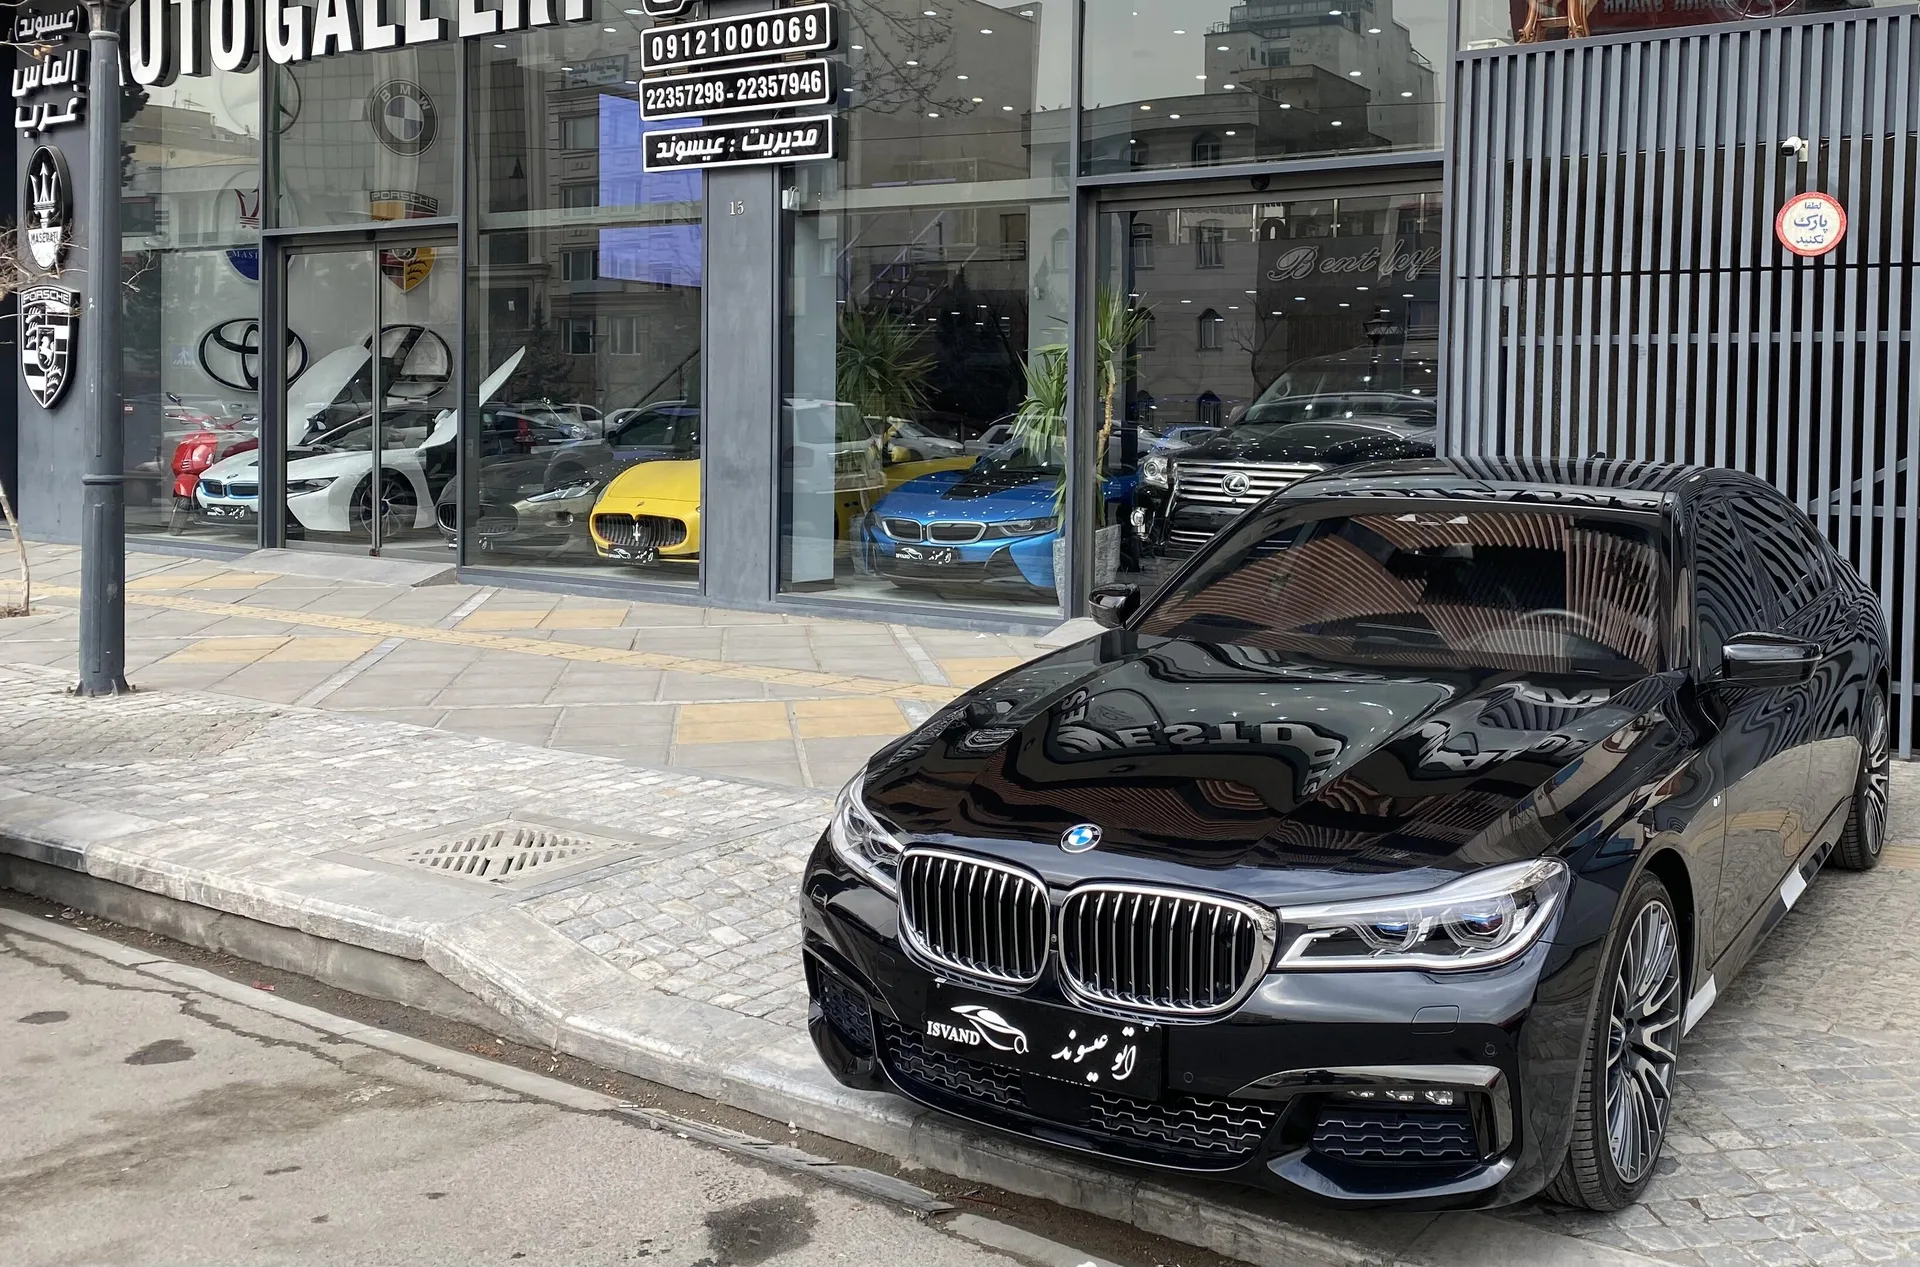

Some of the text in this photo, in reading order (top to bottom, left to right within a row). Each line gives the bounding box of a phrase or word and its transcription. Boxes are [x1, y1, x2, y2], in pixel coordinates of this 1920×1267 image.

[118, 0, 247, 86] UTO
[652, 14, 817, 61] 09121000069
[12, 49, 78, 97] الماس
[379, 84, 431, 111] BMW
[655, 135, 725, 162] عیسوند
[741, 128, 818, 156] مدیریت
[371, 191, 437, 209] PORSCHE
[730, 201, 745, 216] 15
[1793, 214, 1829, 234] پارک
[1796, 234, 1824, 247] نکنید
[1267, 239, 1442, 282] Bentley
[23, 290, 70, 305] PORSCHE
[926, 1020, 981, 1047] ISVAND
